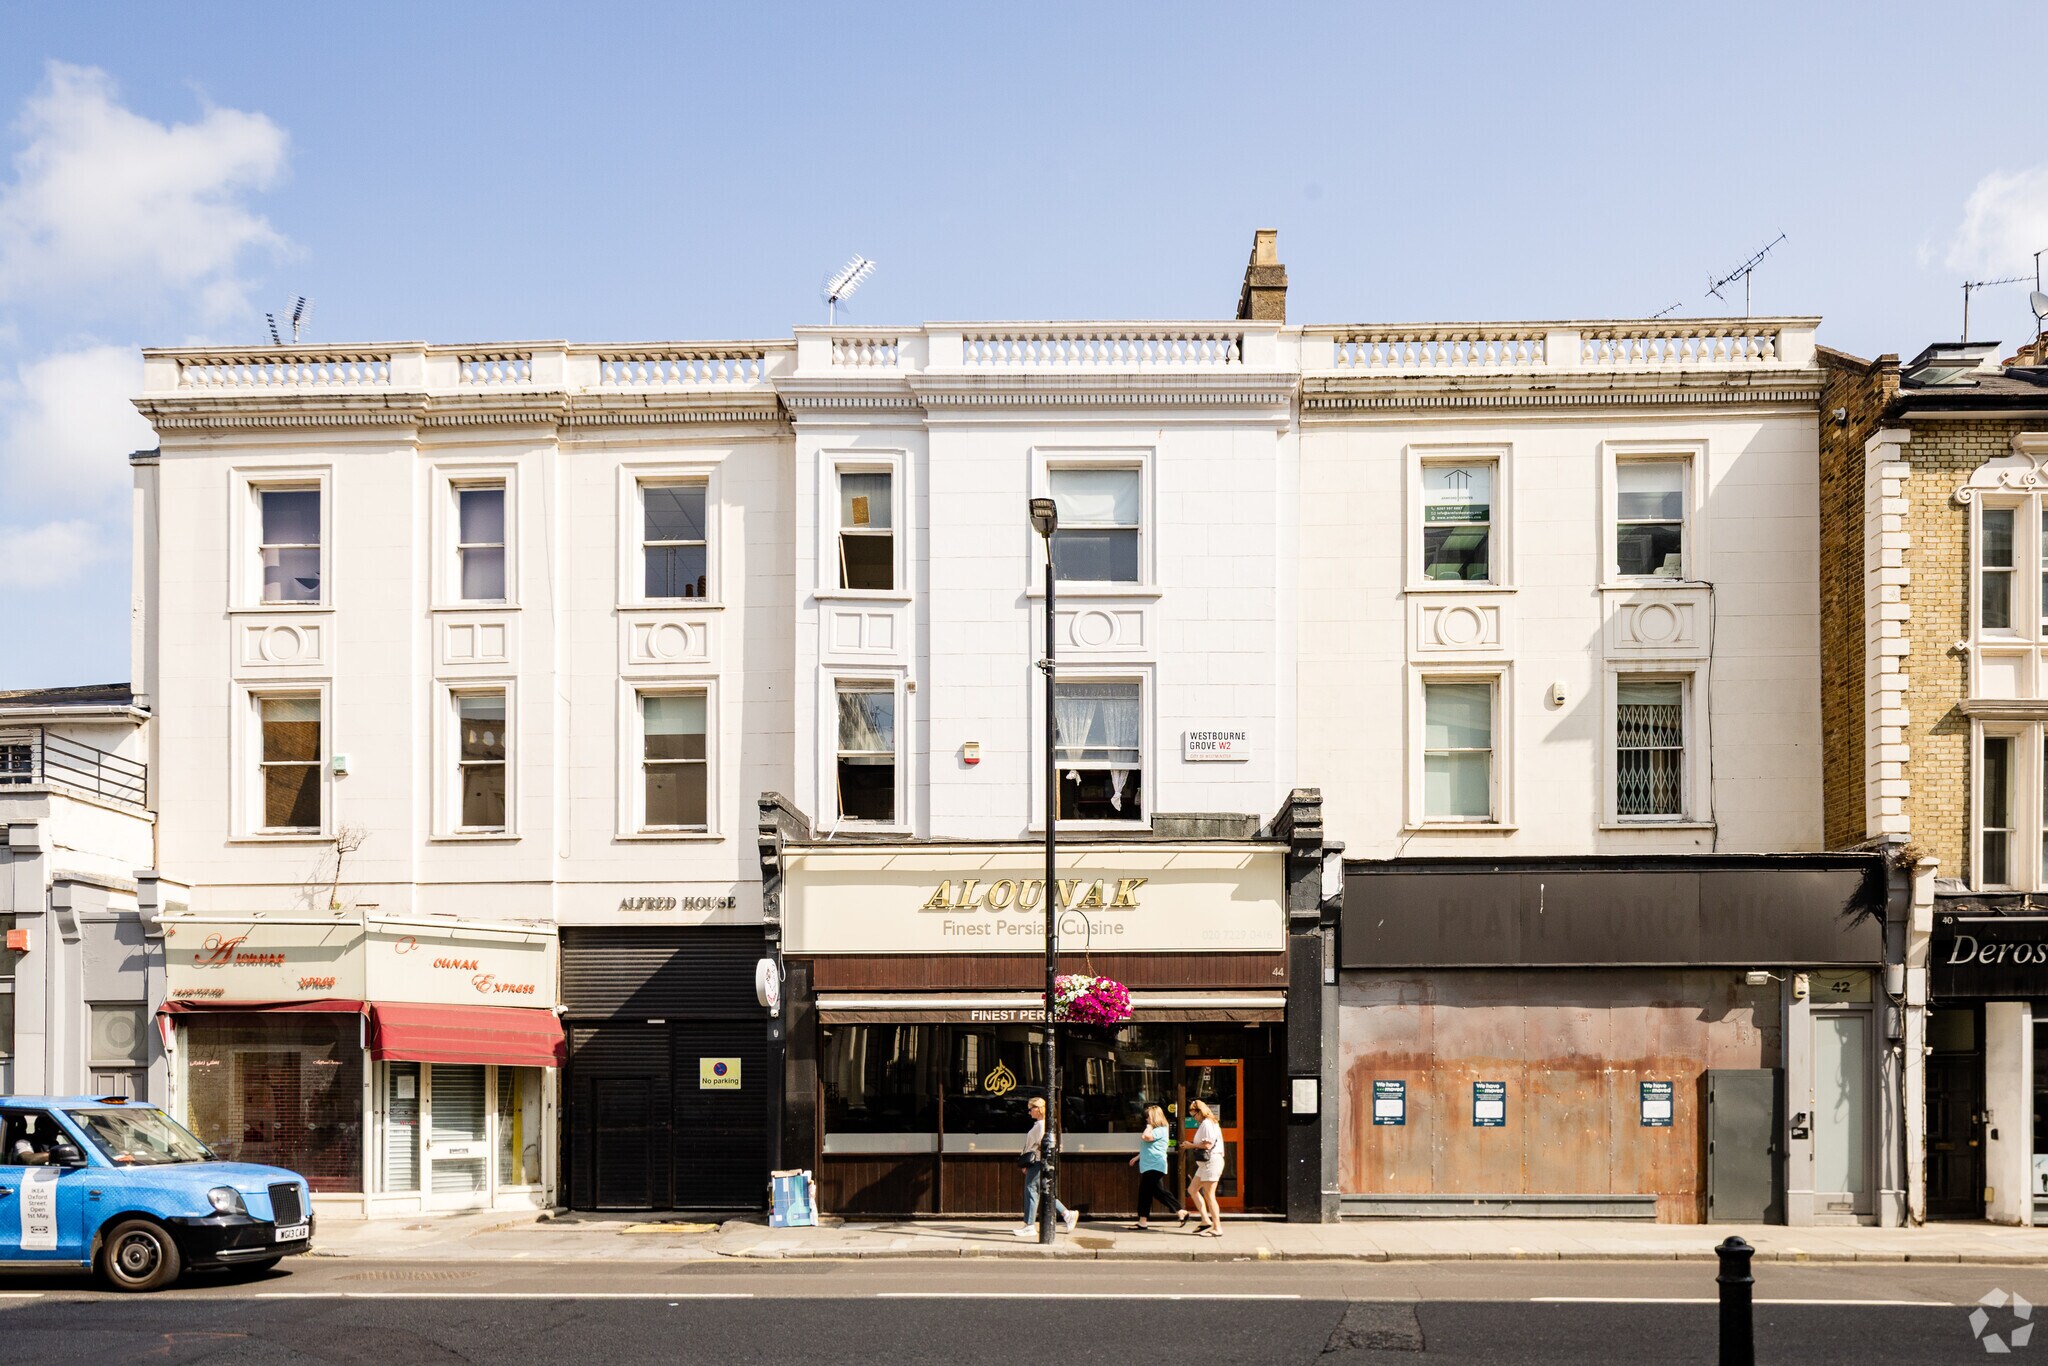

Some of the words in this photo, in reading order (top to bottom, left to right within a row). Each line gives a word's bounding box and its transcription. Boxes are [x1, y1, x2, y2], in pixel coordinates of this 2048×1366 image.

[1190, 732, 1246, 740] WESTBOURNE
[923, 878, 1148, 908] ALOUNAK
[618, 897, 677, 910] ALFRED
[683, 896, 737, 910] HOUSE
[1942, 916, 1953, 924] 40
[943, 920, 990, 936] Finest
[996, 920, 1046, 936] Persia
[1272, 967, 1284, 976] 44
[1831, 982, 1850, 993] 42
[971, 1010, 1017, 1021] FINEST
